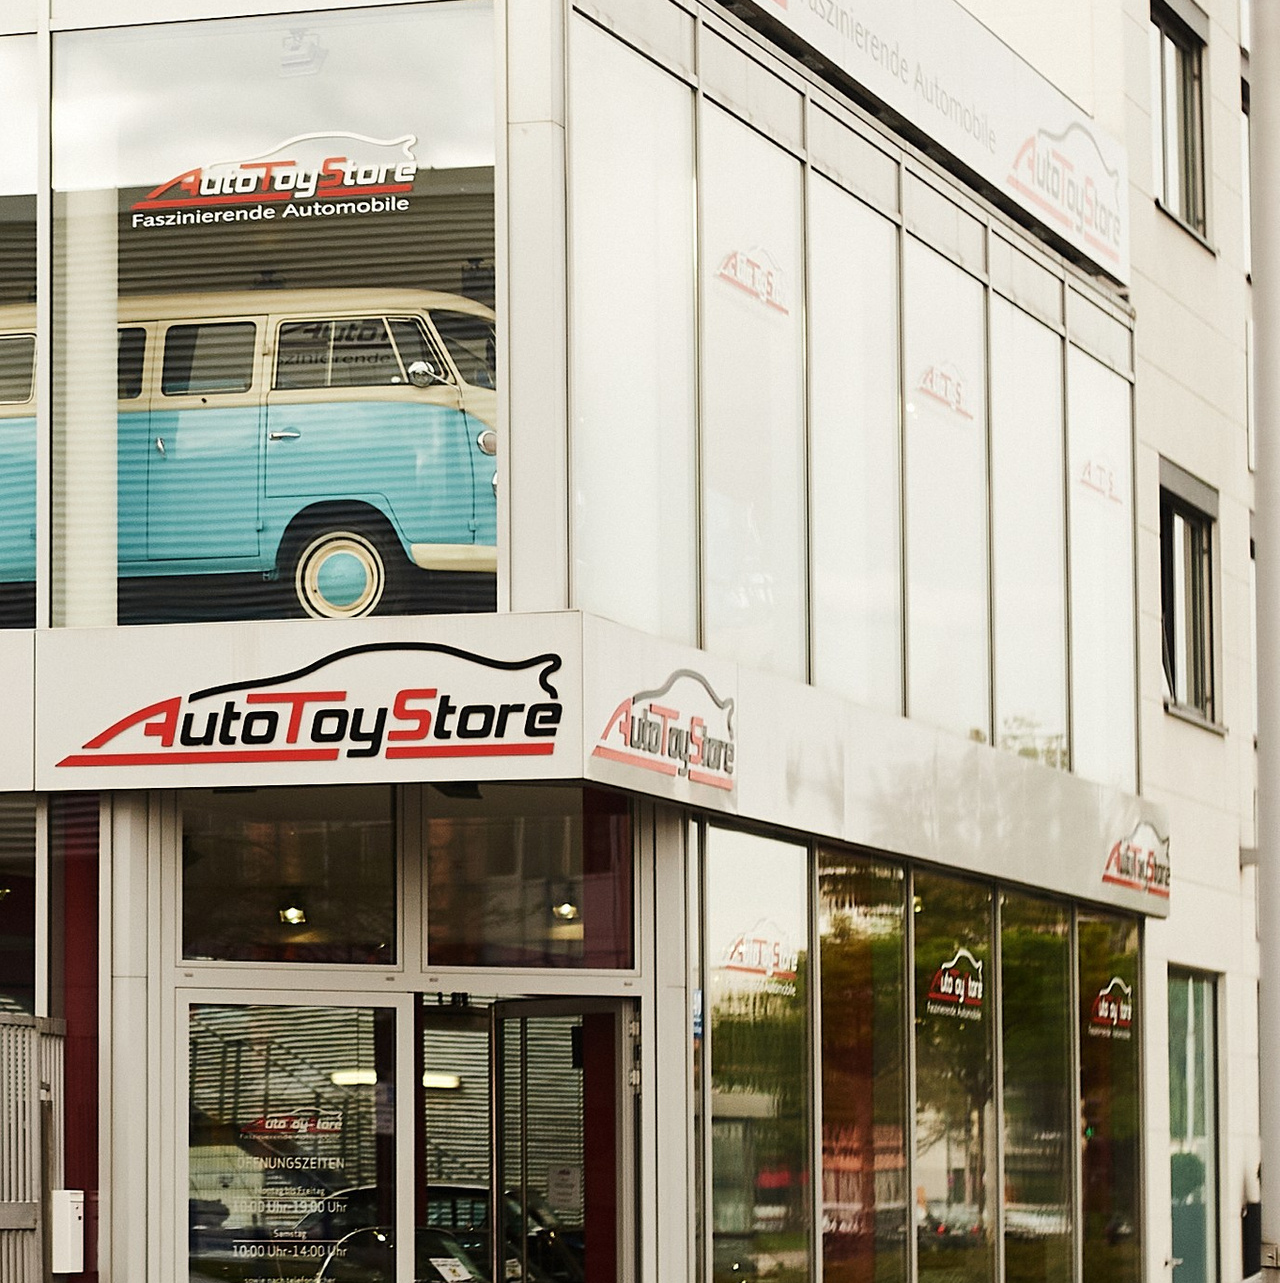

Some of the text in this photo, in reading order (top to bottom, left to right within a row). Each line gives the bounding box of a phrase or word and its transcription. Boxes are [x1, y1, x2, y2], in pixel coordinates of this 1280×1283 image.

[913, 62, 997, 155] Automobile
[131, 197, 410, 228] Faszinierende Automobile
[145, 157, 418, 199] AutoToyStore
[82, 688, 562, 758] AutoToyStore
[601, 698, 735, 777] AutoToyStore
